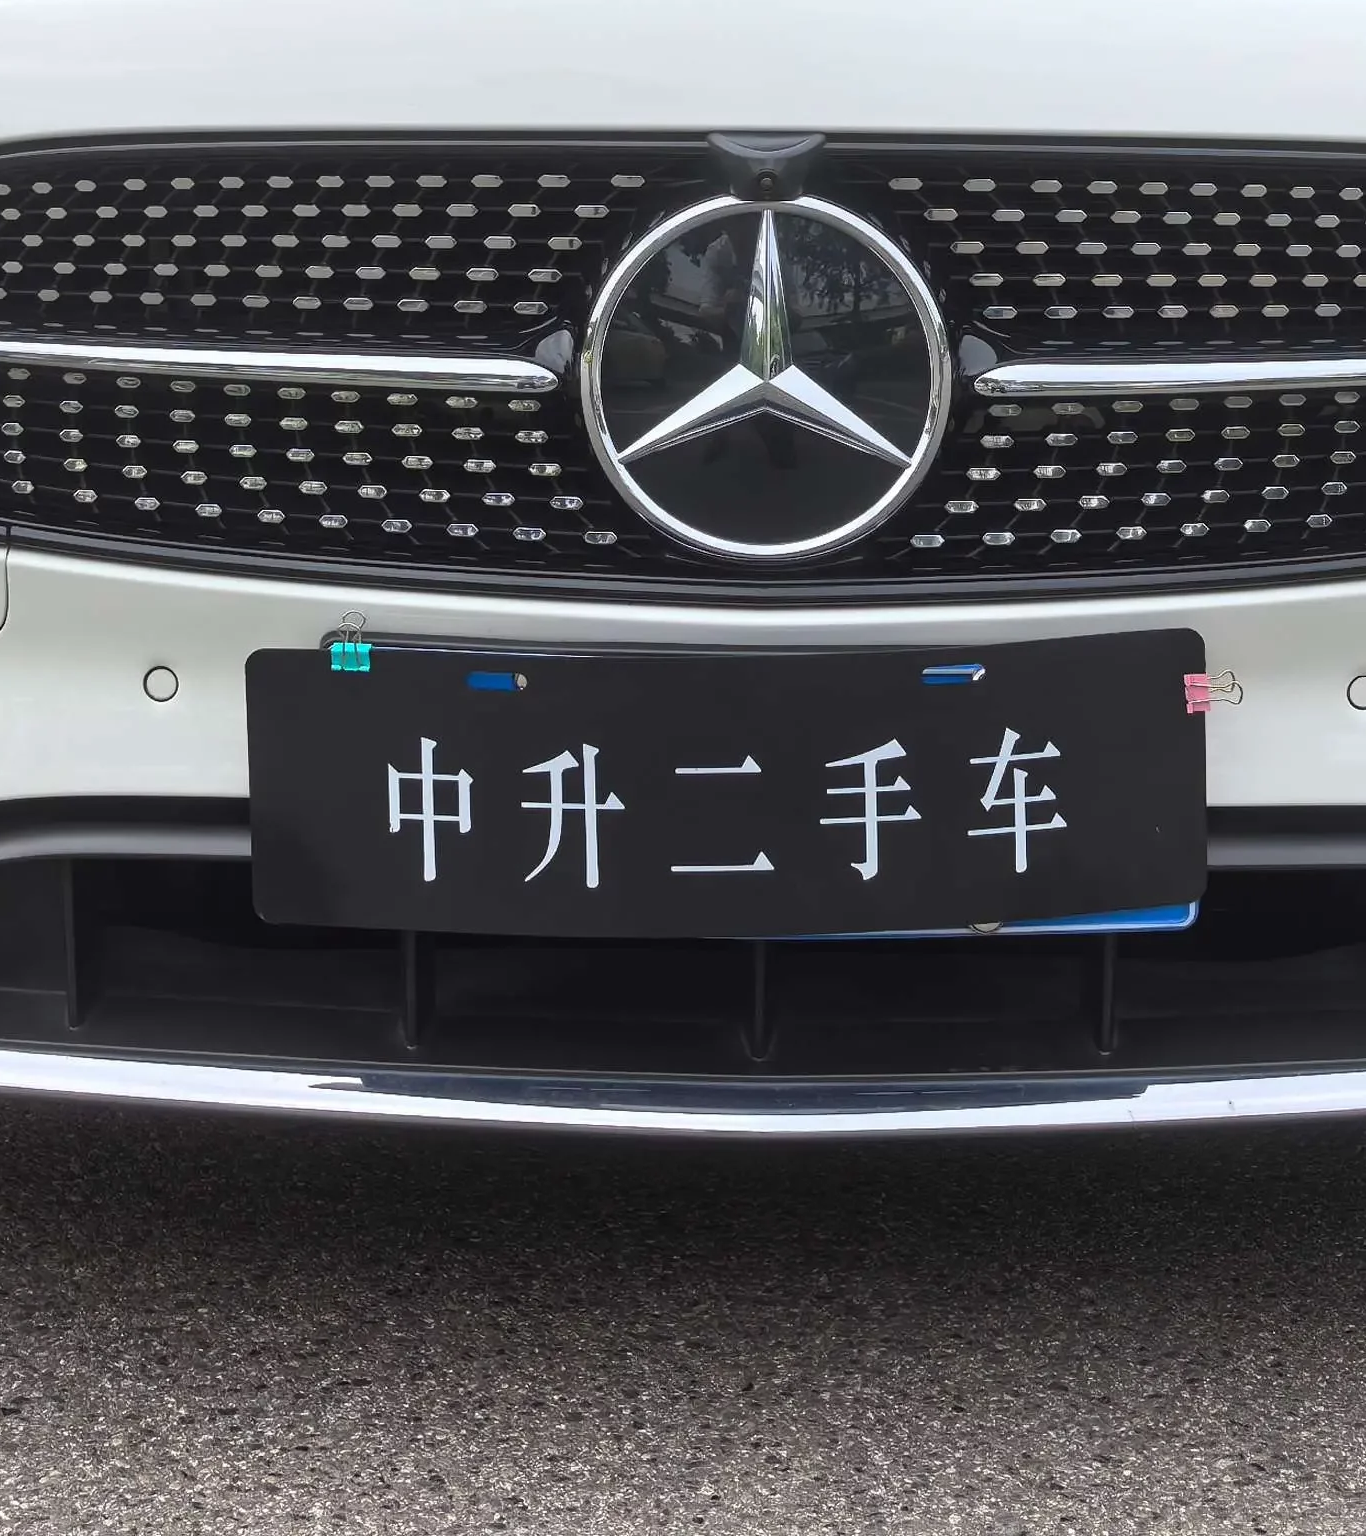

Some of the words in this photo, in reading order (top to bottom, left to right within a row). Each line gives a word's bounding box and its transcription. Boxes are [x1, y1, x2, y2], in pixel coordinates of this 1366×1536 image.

[388, 727, 1068, 889] 中升二手车
